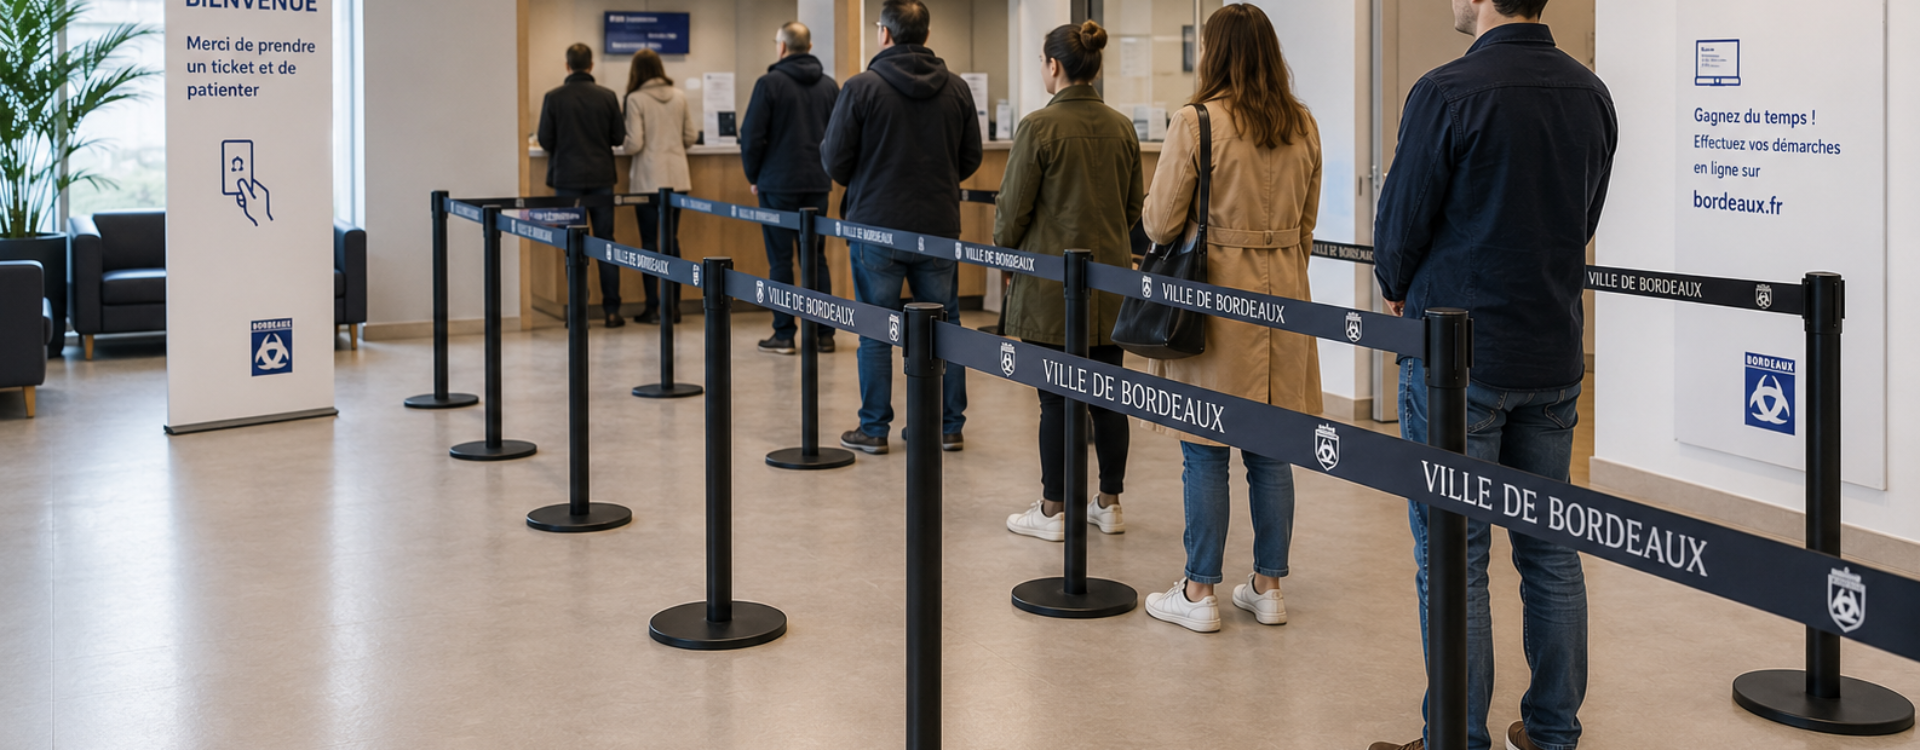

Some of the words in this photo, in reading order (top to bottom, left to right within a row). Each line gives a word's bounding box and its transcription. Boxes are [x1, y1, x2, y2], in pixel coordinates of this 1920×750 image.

[186, 35, 230, 51] Merci
[234, 36, 254, 52] de
[258, 38, 316, 55] prendre
[187, 62, 206, 73] un
[211, 59, 254, 74] ticket
[259, 61, 274, 74] et
[277, 60, 297, 74] de
[187, 82, 260, 100] patienter
[1694, 107, 1741, 126] Gagnez
[1744, 108, 1761, 124] du
[1764, 110, 1807, 128] temps
[1811, 109, 1816, 125] !
[1694, 134, 1746, 151] Effectuez
[1749, 140, 1769, 151] vos
[1772, 138, 1841, 155] démarches
[1694, 163, 1708, 174] en
[1711, 161, 1739, 179] ligne
[1742, 166, 1761, 178] sur
[1693, 190, 1783, 215] bordeaux.fr
[965, 246, 984, 262] VILLE
[985, 249, 994, 265] DE
[995, 252, 1035, 272] BORDEAUX
[1588, 271, 1618, 288] VILLE
[1621, 274, 1636, 290] DE
[1639, 276, 1702, 298] BORDEAUX
[768, 286, 791, 309] VILLE
[792, 293, 804, 312] DE
[806, 297, 855, 327] BORDEAUX
[1162, 282, 1193, 305] VILLE
[1197, 289, 1212, 309] DE
[1216, 293, 1285, 324] BORDEAUX
[1747, 355, 1794, 372] BORDEAUX
[1042, 358, 1087, 393] VILLE
[1093, 372, 1115, 401] DE
[1121, 379, 1225, 434] BORDEAUX
[1421, 460, 1493, 510] VILLE
[1503, 483, 1538, 524] DE
[1548, 496, 1708, 577] BORDEAUX
